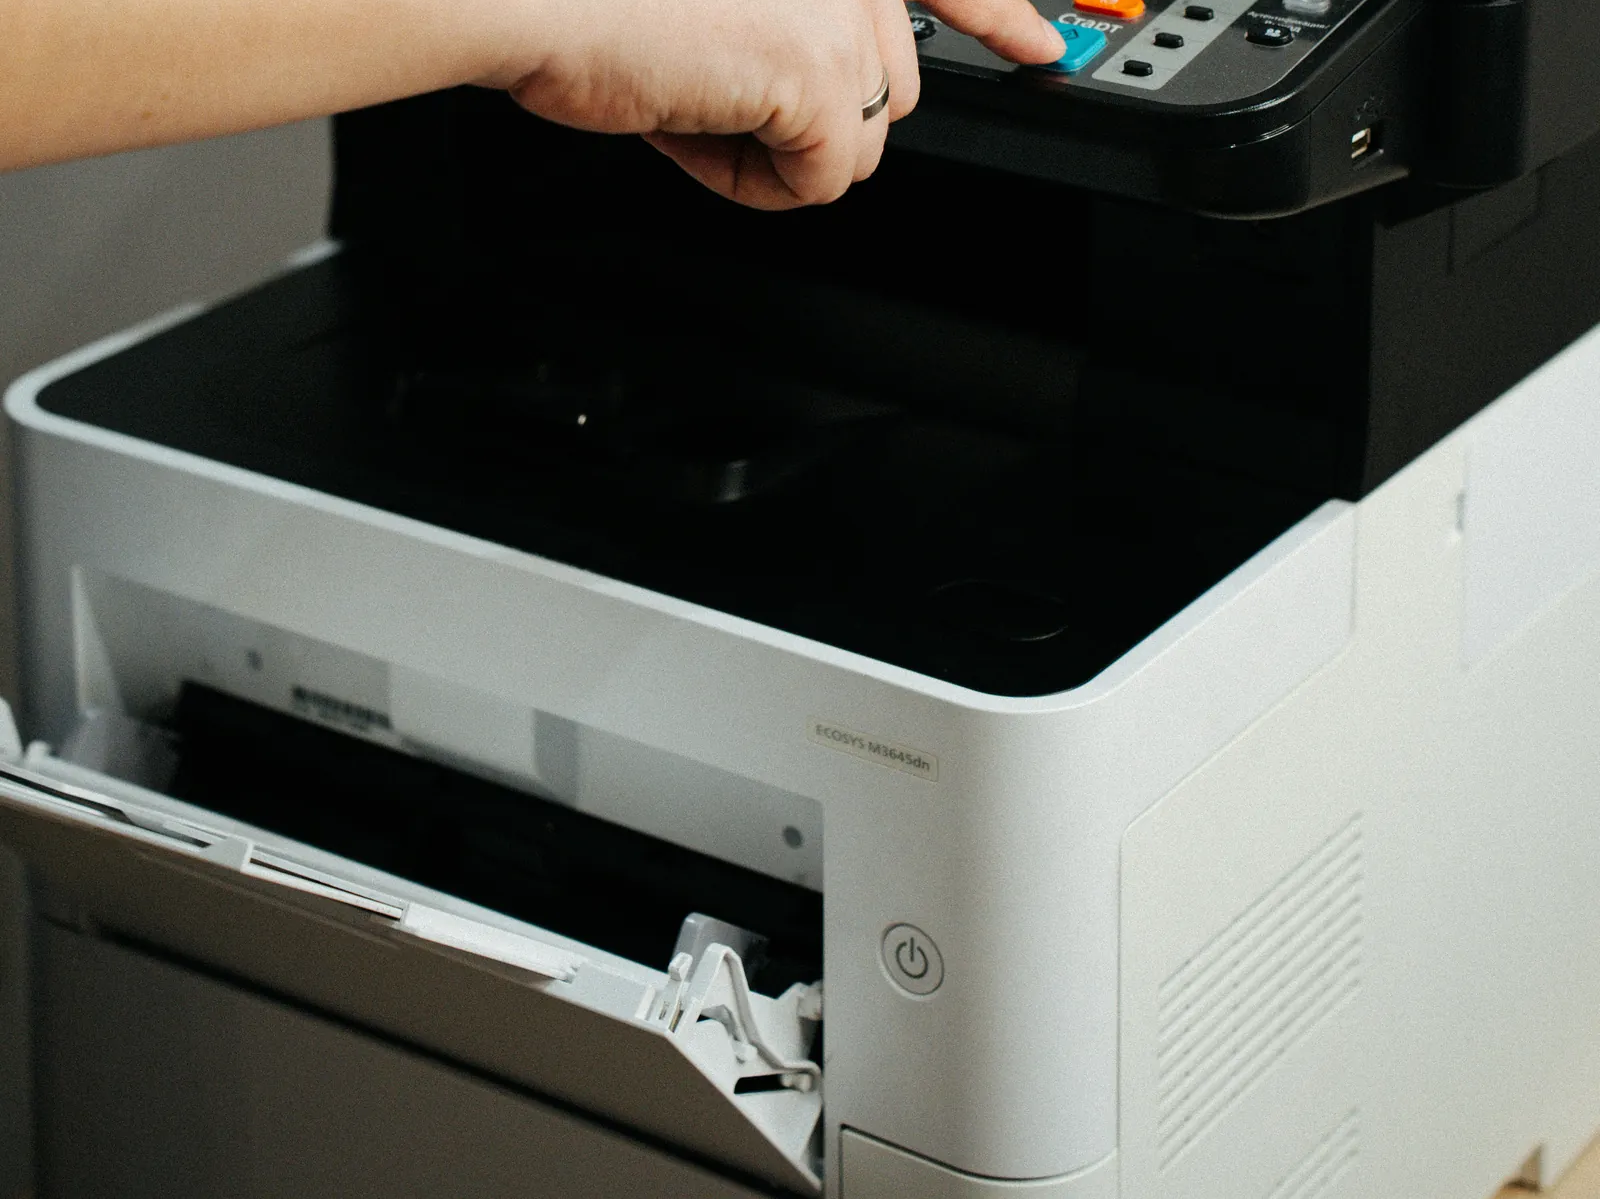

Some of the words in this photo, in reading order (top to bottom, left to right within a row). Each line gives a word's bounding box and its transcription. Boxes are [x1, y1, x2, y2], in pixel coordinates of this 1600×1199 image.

[1058, 12, 1124, 33] Старт
[814, 723, 865, 750] ECOSYS
[867, 741, 931, 772] M3645dn
